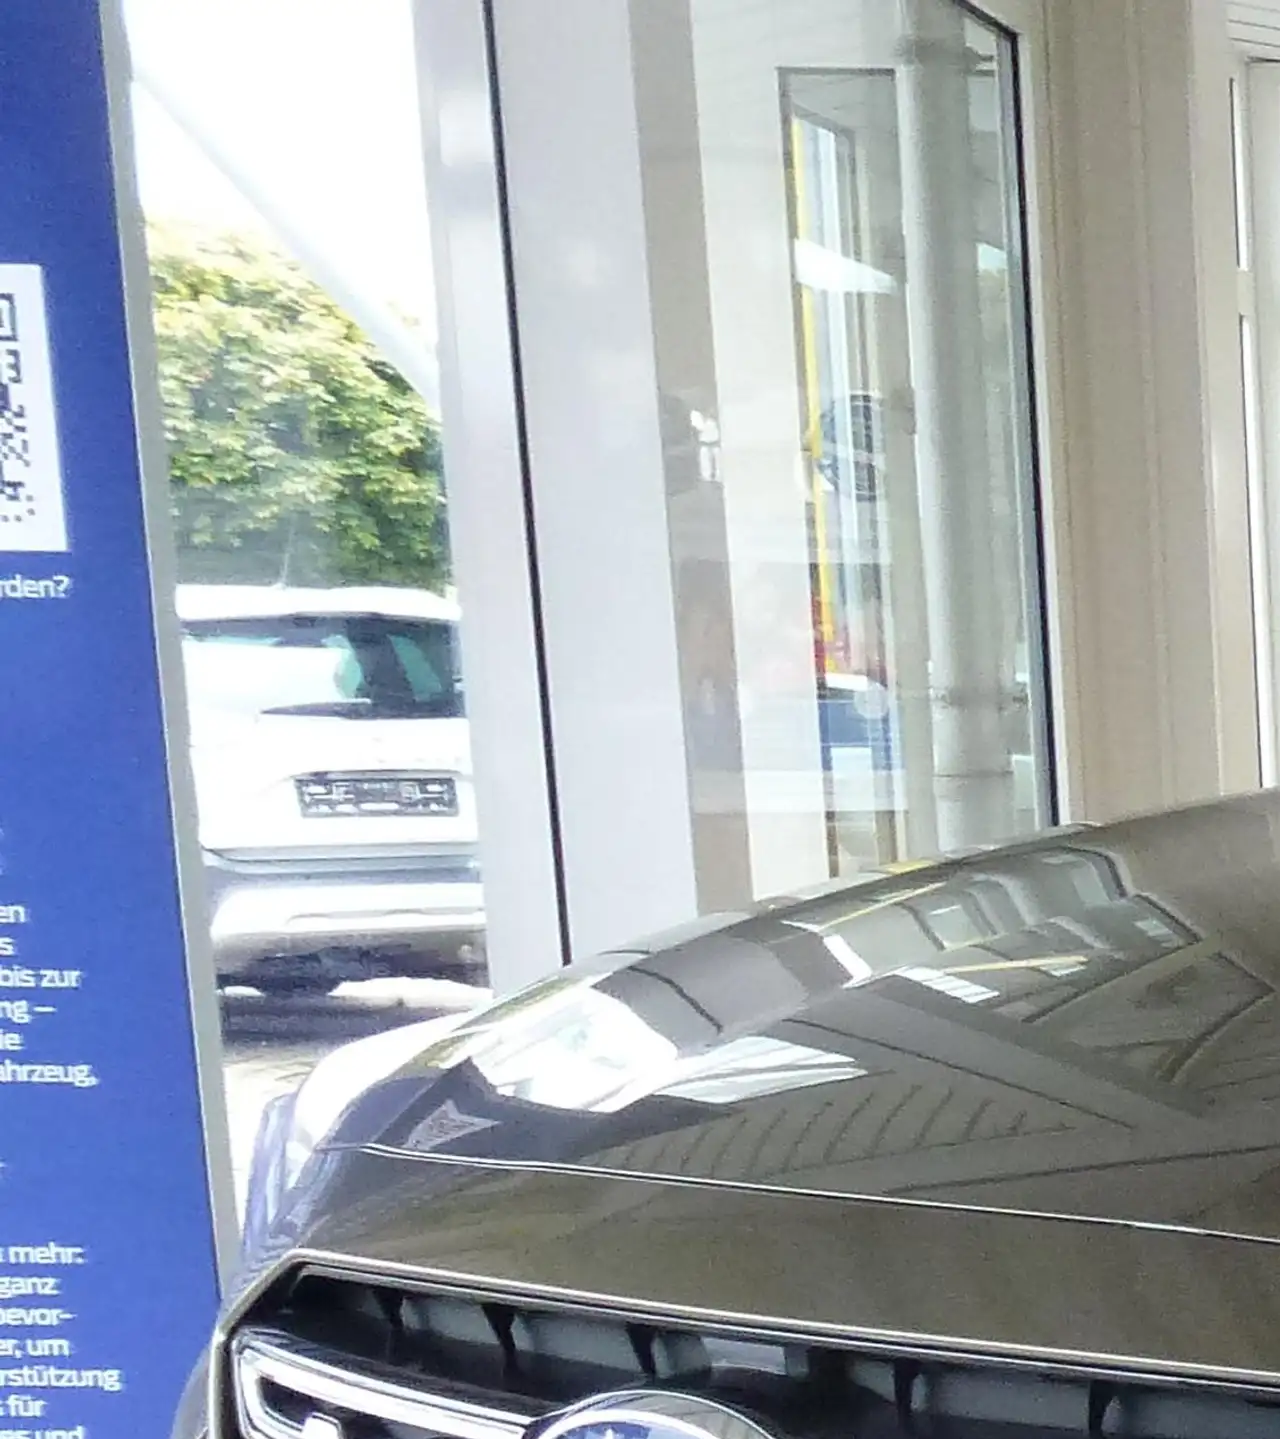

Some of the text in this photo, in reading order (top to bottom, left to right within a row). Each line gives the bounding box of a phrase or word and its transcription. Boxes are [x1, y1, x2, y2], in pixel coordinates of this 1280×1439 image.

[40, 968, 82, 988] zur
[0, 1276, 61, 1298] ganz
[26, 1338, 71, 1357] um
[6, 1394, 48, 1417] für
